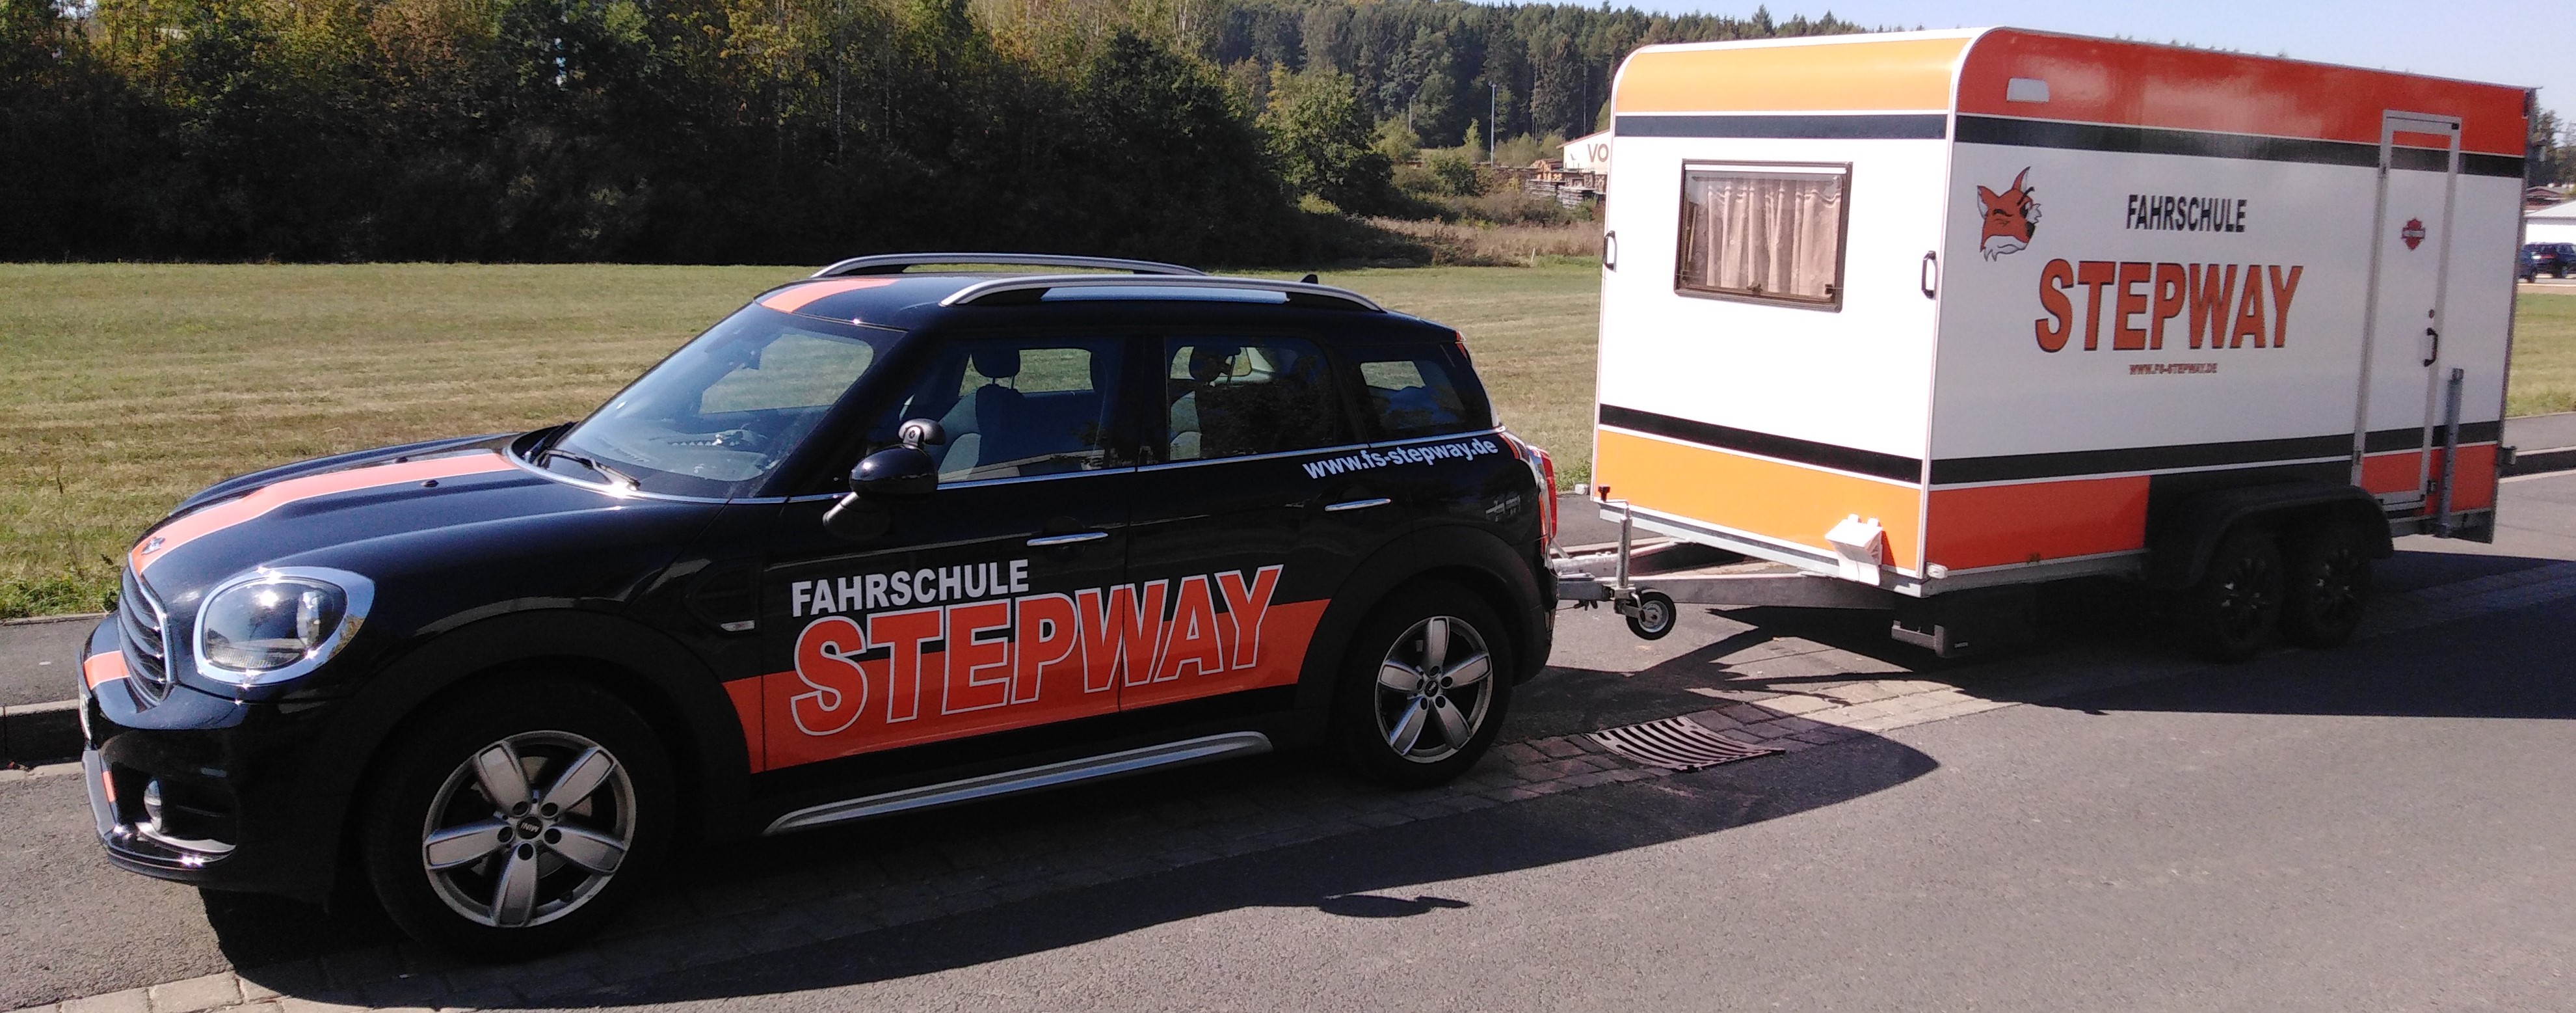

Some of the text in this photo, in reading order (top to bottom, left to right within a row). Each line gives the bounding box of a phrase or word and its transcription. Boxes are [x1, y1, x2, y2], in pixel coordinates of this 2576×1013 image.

[2127, 195, 2247, 232] FAHRSCHULE
[2035, 259, 2304, 353] STEPWAY
[1303, 439, 1498, 479] www.fs-stepway.de
[791, 560, 1029, 617] FAHRSCHULE
[791, 564, 1284, 736] STEPWAY
[520, 822, 540, 833] MINI
